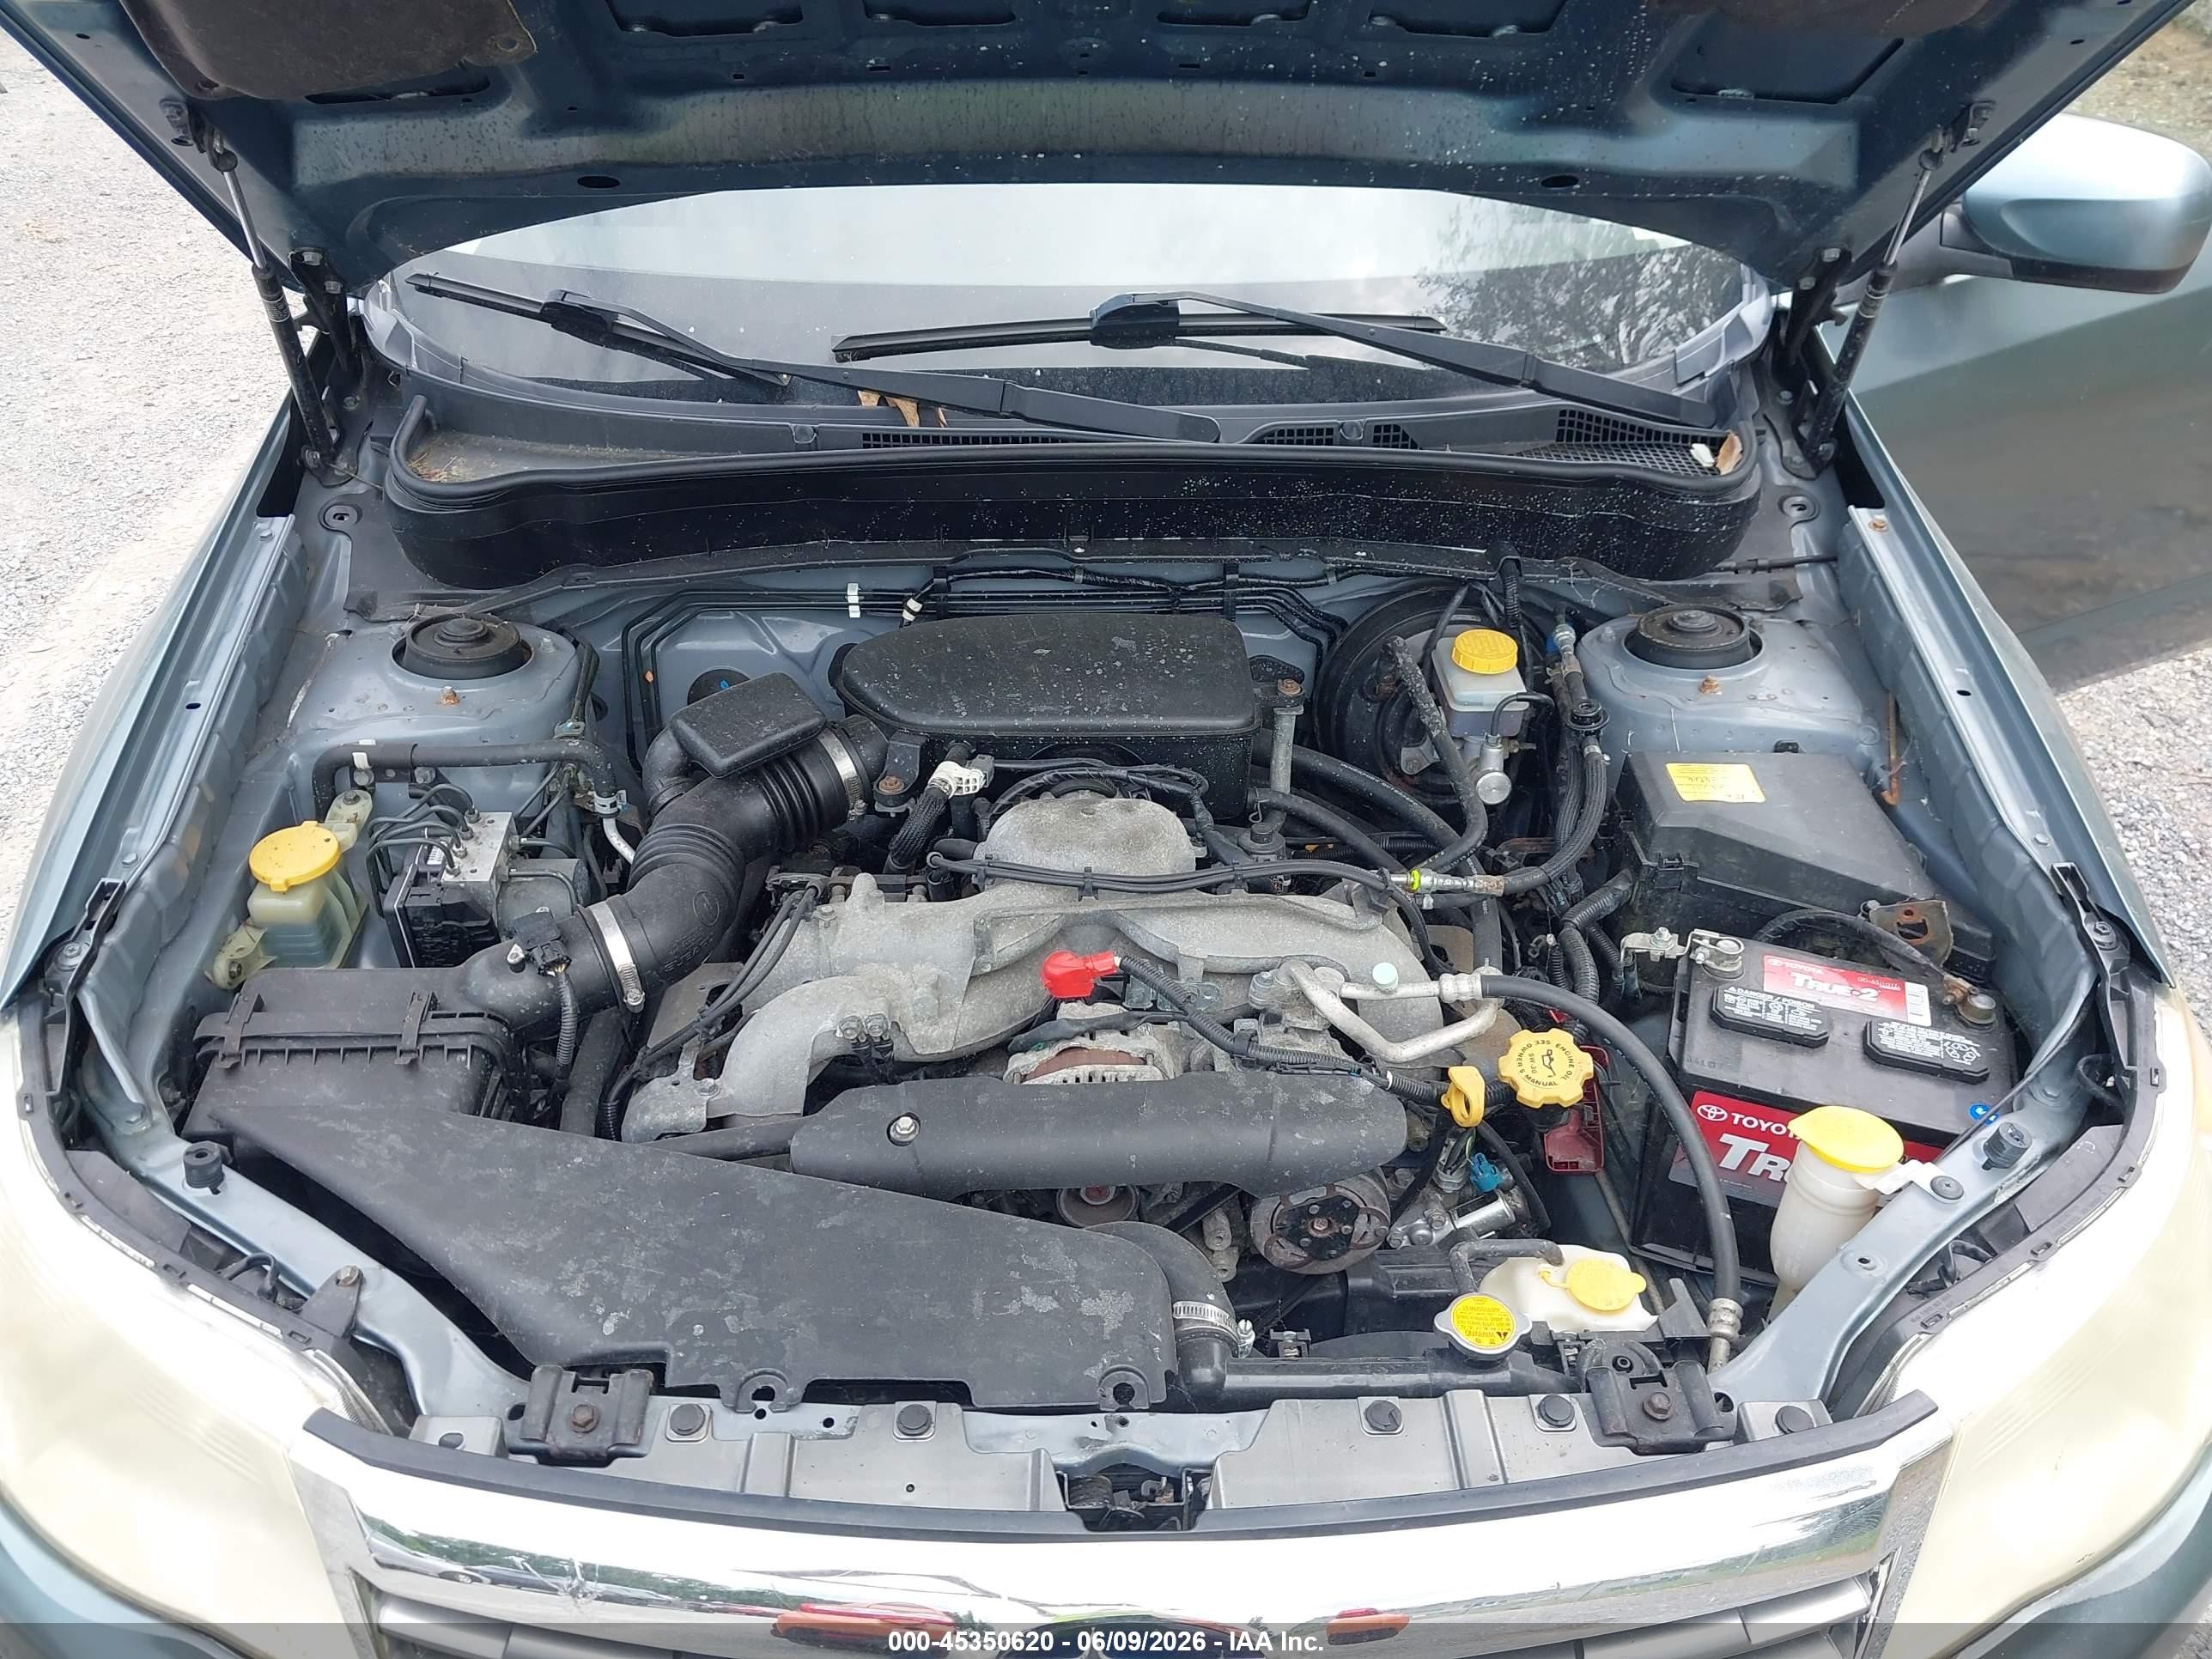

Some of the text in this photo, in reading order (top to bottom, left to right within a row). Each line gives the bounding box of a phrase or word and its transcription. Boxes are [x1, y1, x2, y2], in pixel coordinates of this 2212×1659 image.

[1783, 961, 1825, 975] TOYOTA
[1555, 1042, 1575, 1080] ENGINE OIL
[1524, 1074, 1559, 1086] MANUAL
[1731, 1112, 1801, 1140] TOYO
